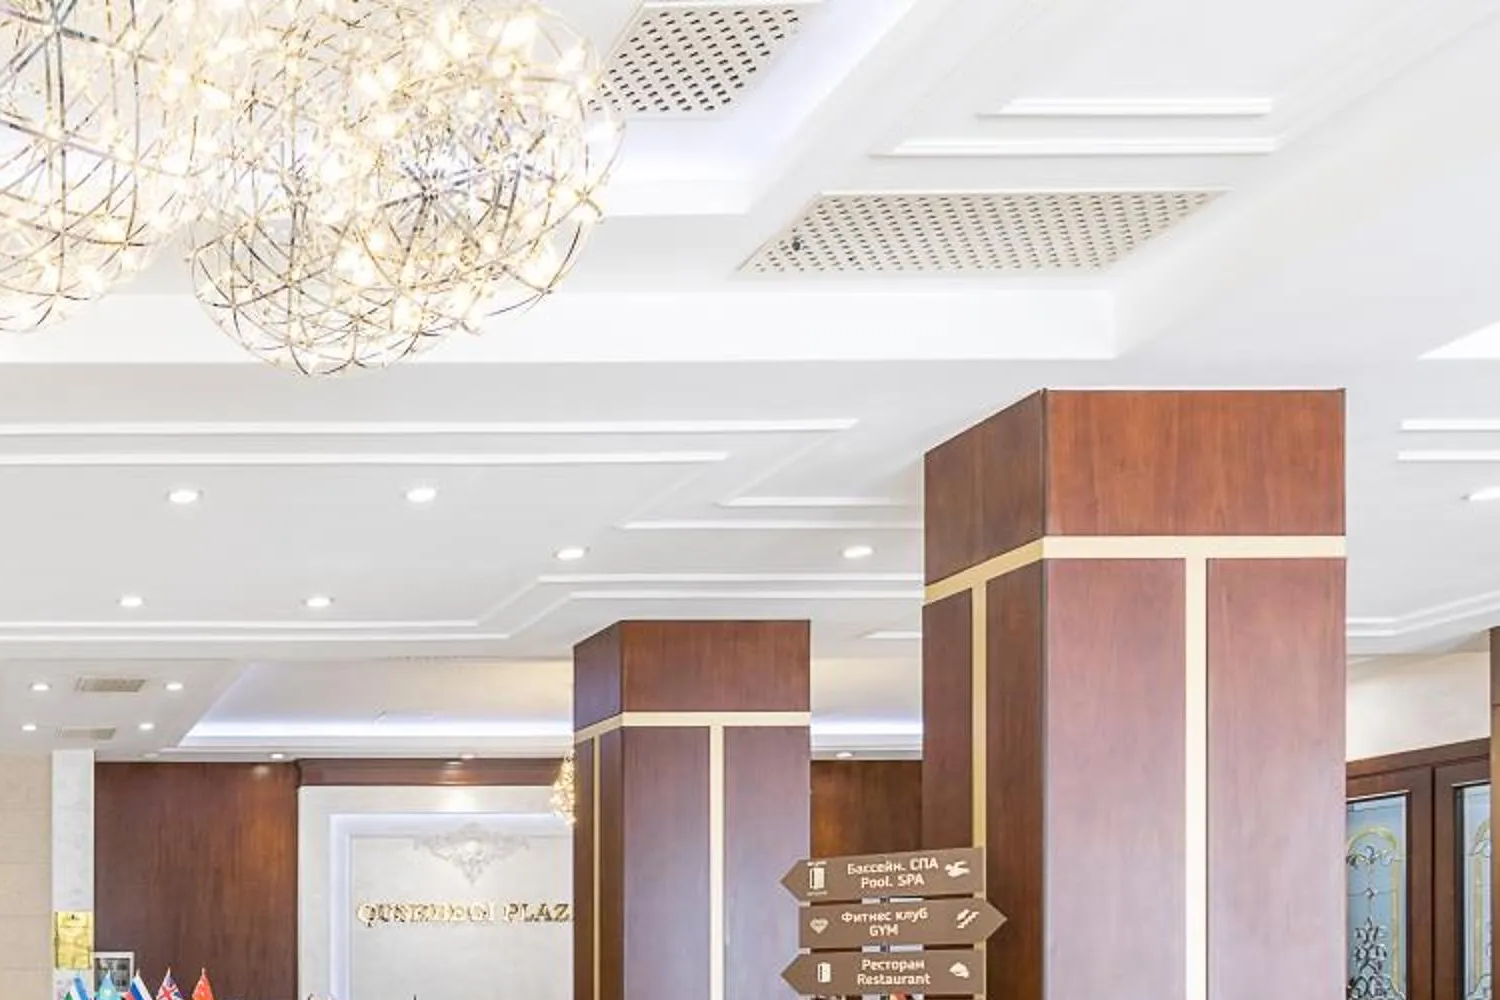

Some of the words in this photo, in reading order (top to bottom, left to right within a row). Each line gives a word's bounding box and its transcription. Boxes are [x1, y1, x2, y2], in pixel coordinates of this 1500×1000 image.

[910, 857, 939, 871] СПА
[861, 875, 893, 888] Pool.
[897, 873, 925, 887] SPA
[503, 902, 574, 923] PLAZ
[841, 911, 892, 923] Фитнес
[895, 907, 928, 923] клуб
[869, 924, 899, 937] GYM
[862, 959, 925, 972] Ресторан
[857, 972, 931, 985] Restaurant
